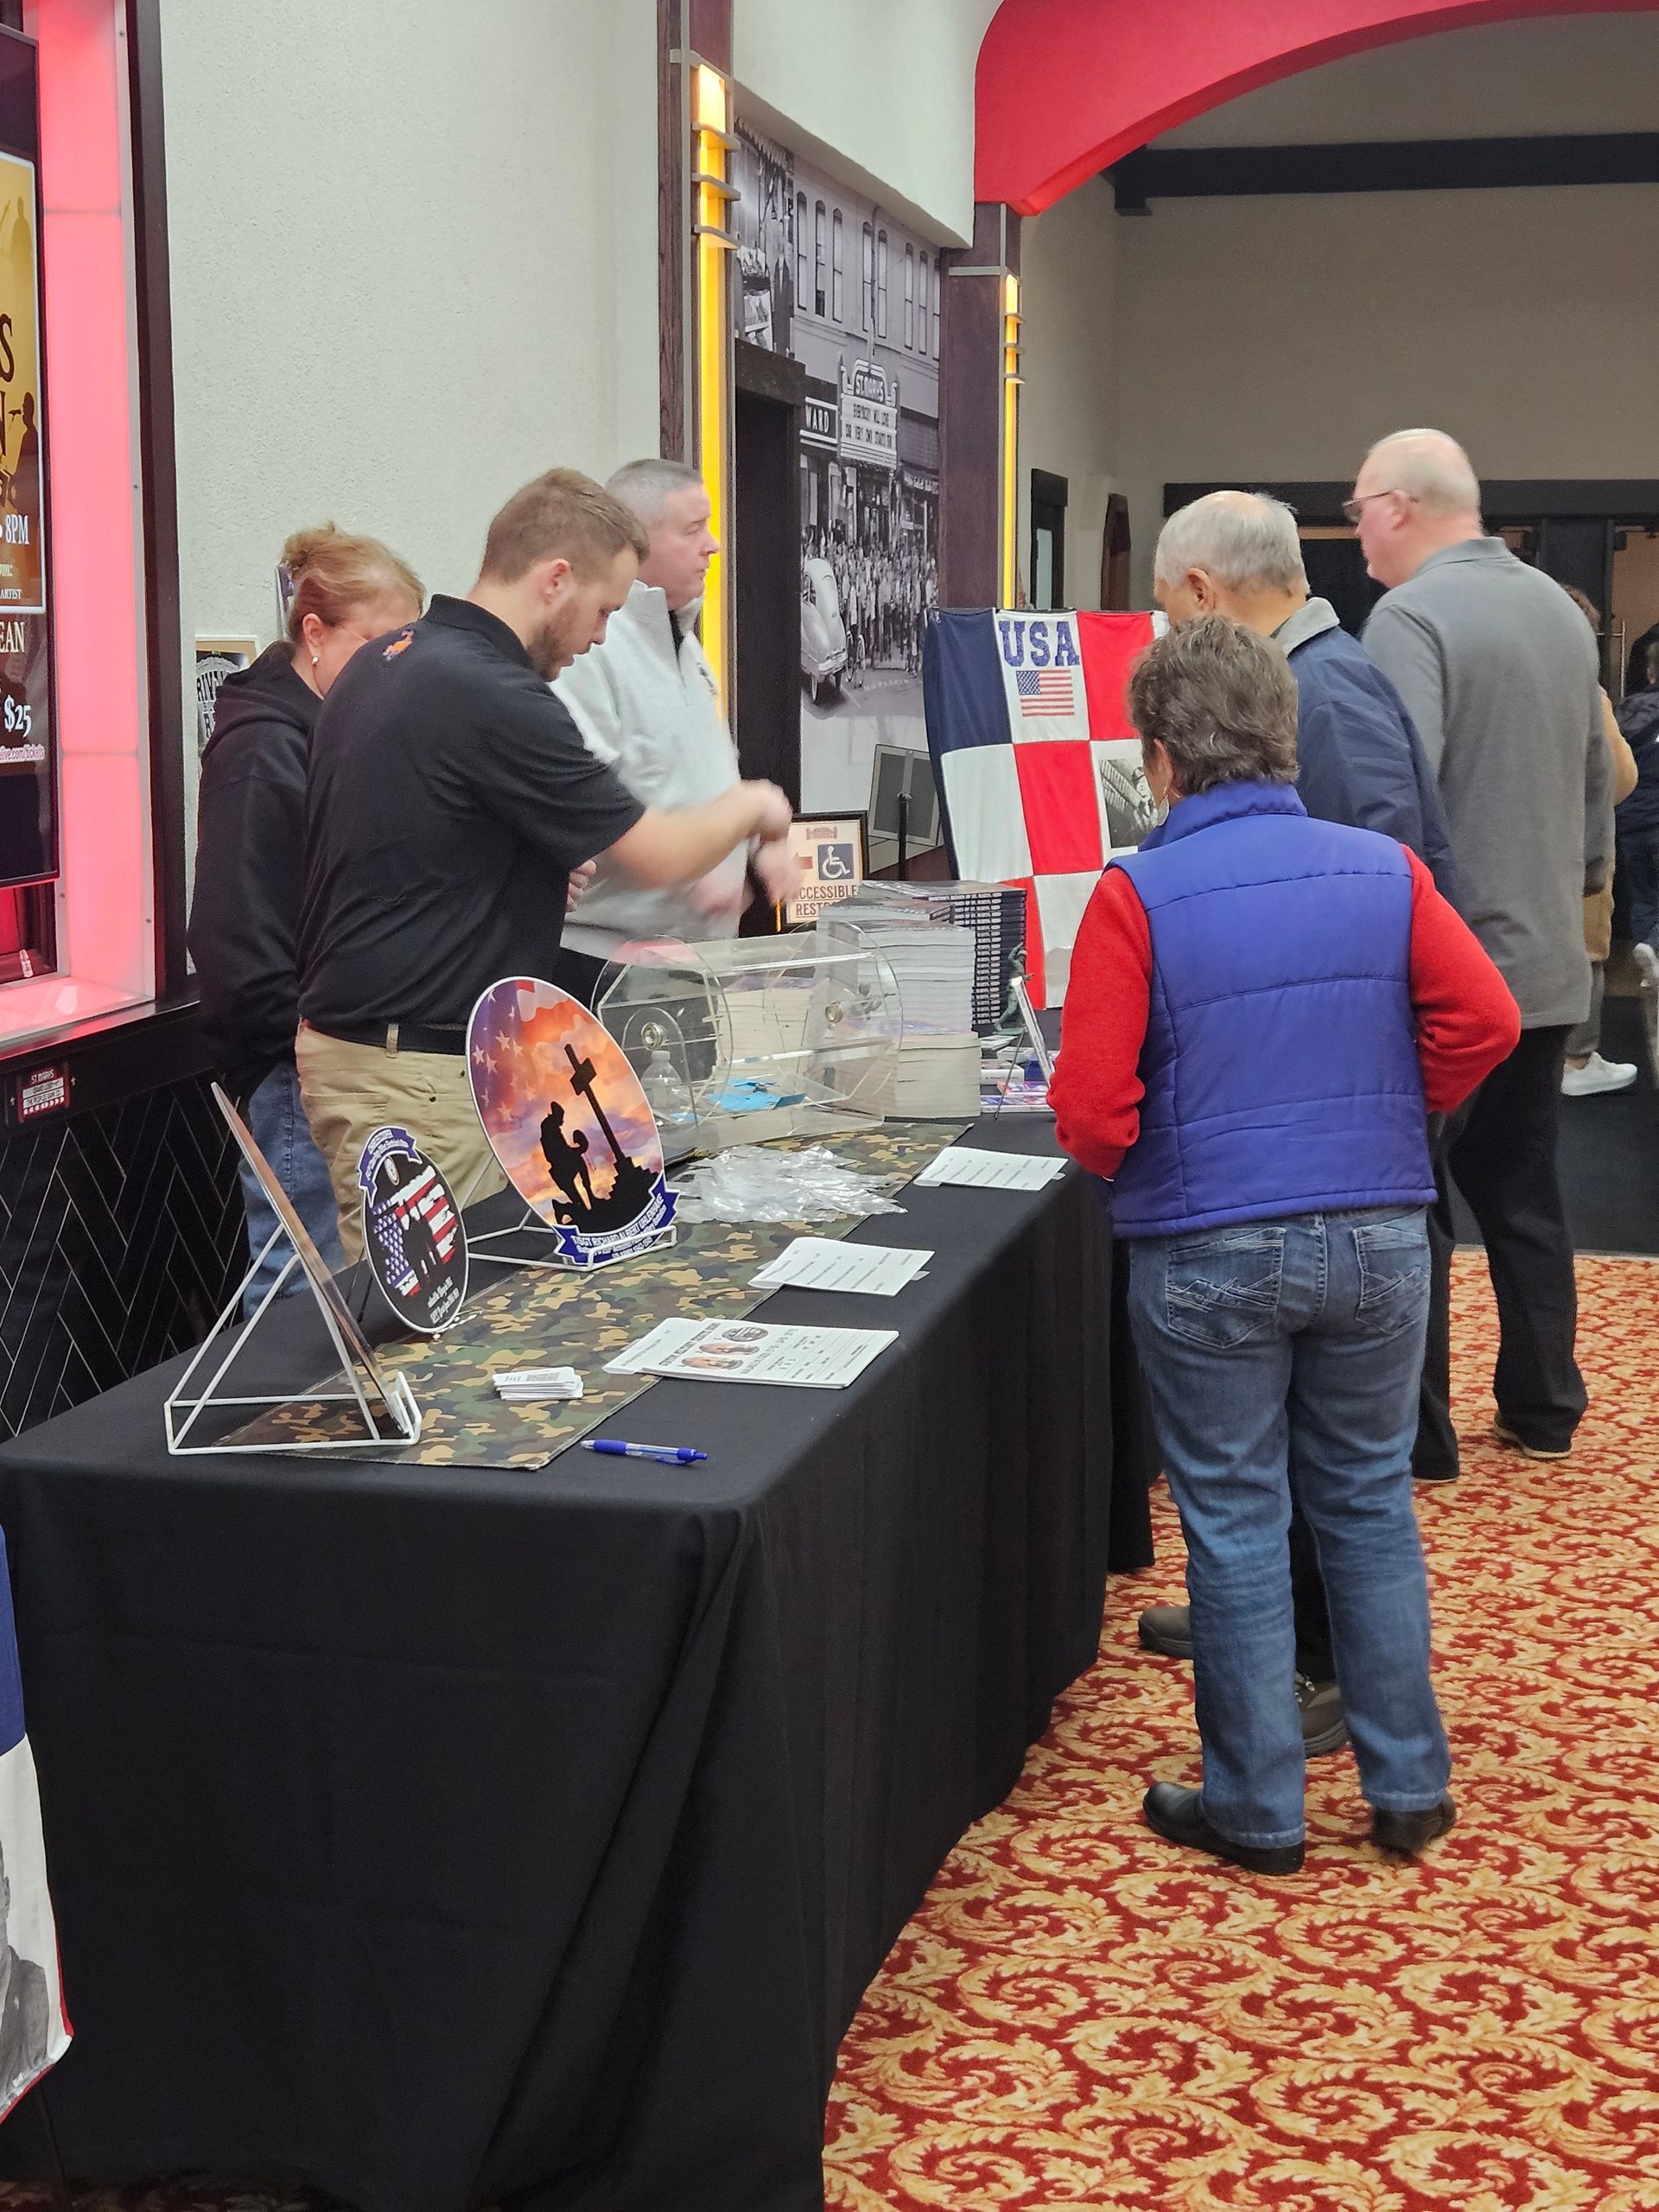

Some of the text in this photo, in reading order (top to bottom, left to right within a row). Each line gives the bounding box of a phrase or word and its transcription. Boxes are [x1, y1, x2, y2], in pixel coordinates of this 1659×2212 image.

[805, 404, 830, 433] WARD
[5, 513, 29, 545] 8PM
[0, 588, 22, 600] ARTIST
[999, 620, 1080, 667] USA
[4, 694, 32, 738] $25
[795, 884, 858, 899] CCESSIBLE
[592, 1234, 620, 1246] RICHARD
[619, 1226, 640, 1242] ALBERT
